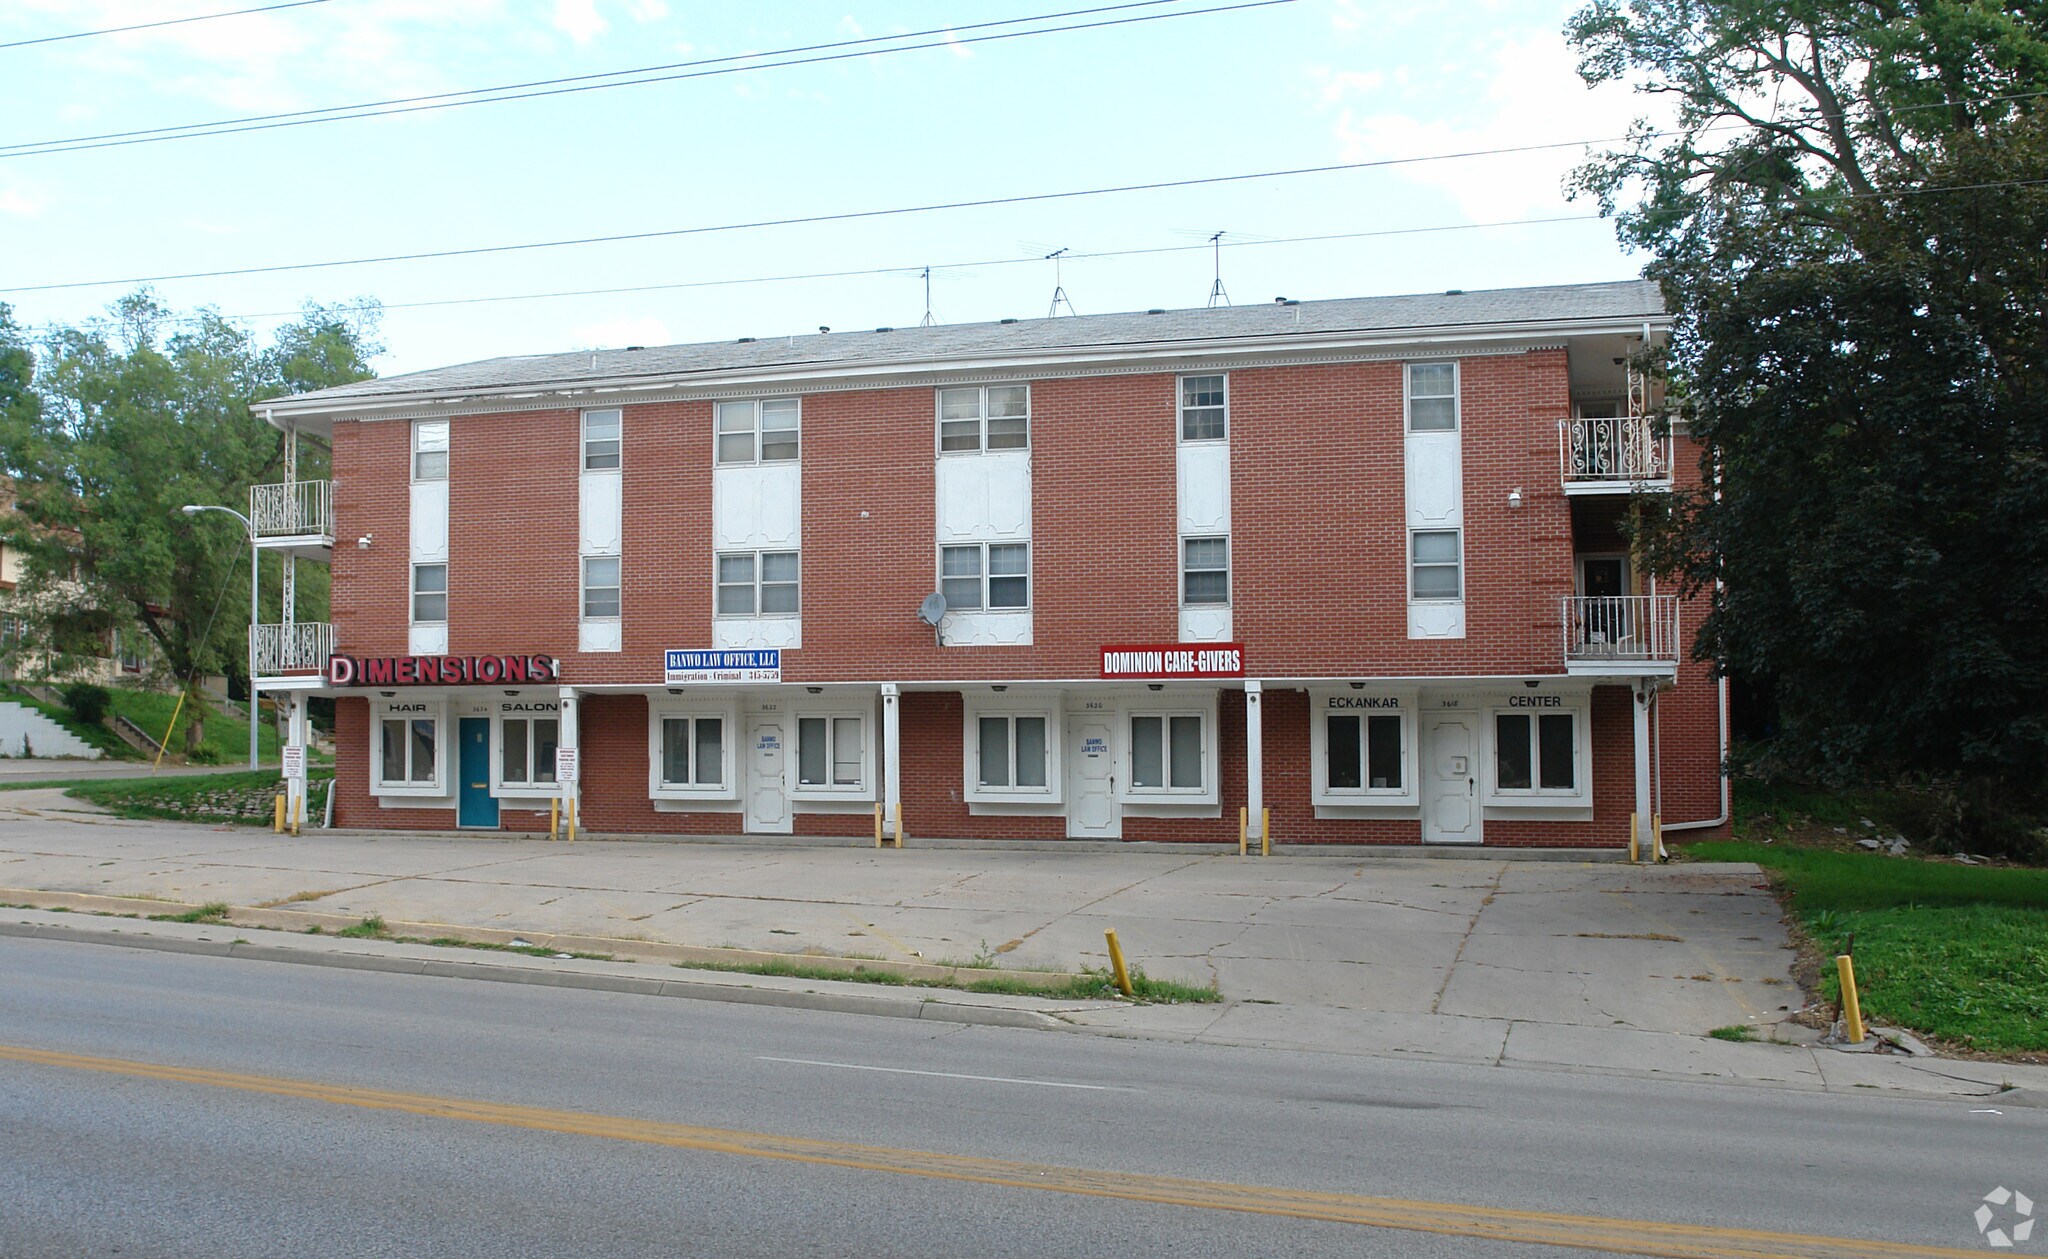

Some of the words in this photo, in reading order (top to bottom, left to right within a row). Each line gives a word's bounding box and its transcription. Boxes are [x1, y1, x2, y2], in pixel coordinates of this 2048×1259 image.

[669, 653, 701, 667] BANWO
[702, 653, 722, 666] LAW
[723, 652, 758, 667] OFFICE,
[760, 652, 777, 666] LLC
[1104, 651, 1163, 673] DOMINION
[1164, 650, 1241, 673] CARE-GIVERS
[329, 654, 554, 687] DIMENSIONS
[667, 671, 708, 681] Immigration
[713, 671, 742, 680] Criminal
[502, 703, 558, 711] SALON
[1329, 697, 1399, 708] ECKANKAR
[1509, 696, 1561, 707] CENTER
[389, 704, 426, 712] HAIR
